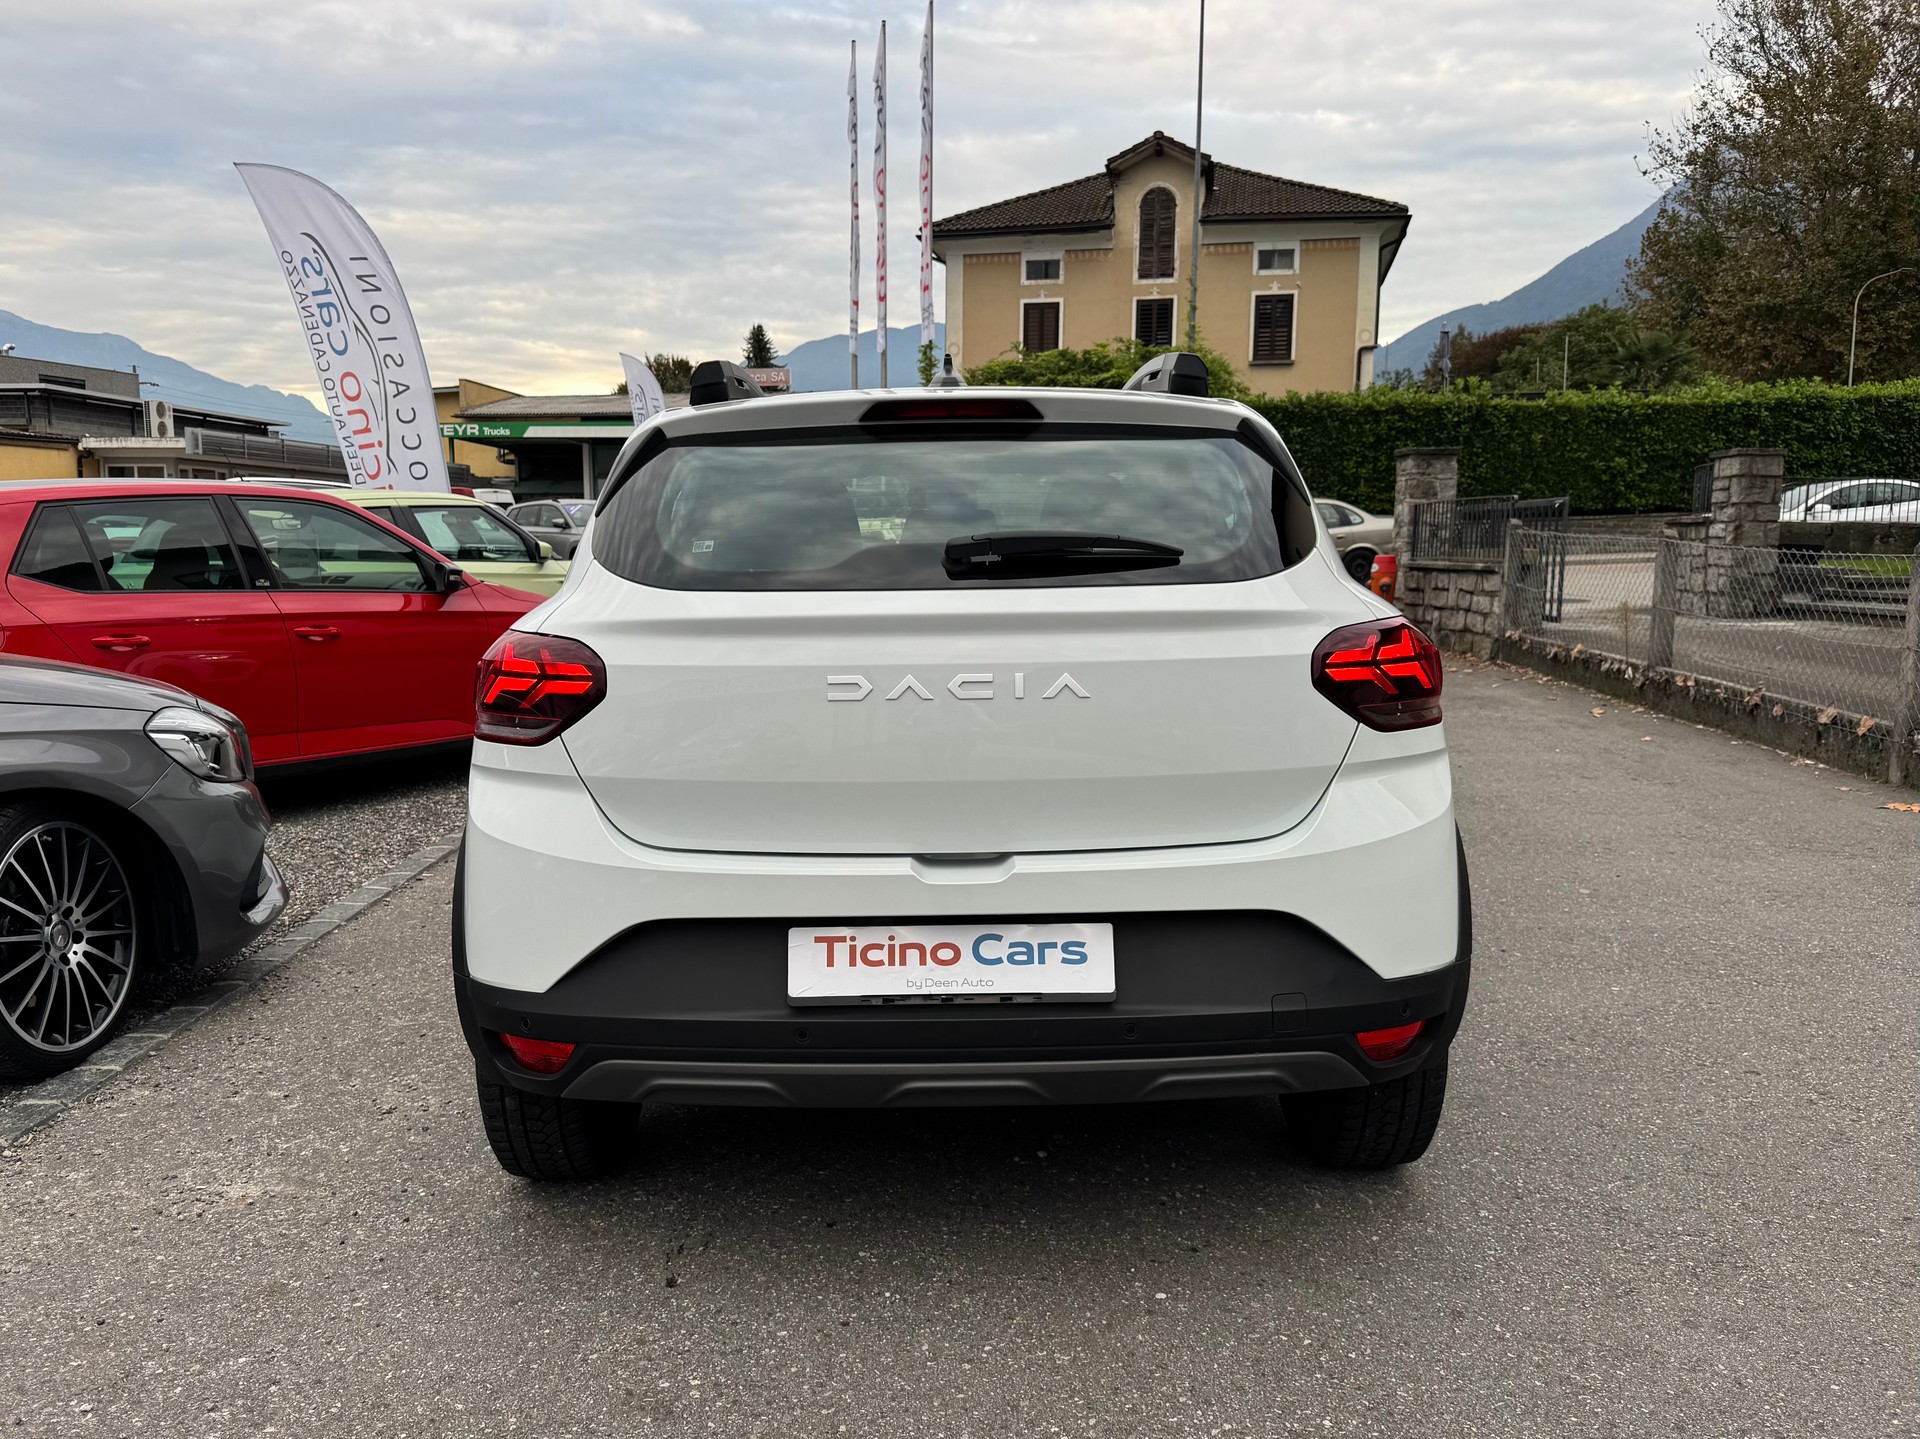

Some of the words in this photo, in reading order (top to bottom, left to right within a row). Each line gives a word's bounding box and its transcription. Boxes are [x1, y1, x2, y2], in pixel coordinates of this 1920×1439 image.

[770, 371, 785, 382] SA
[440, 423, 480, 436] EYR
[482, 426, 511, 436] Trucks
[827, 672, 1091, 702] DACIA
[813, 934, 962, 968] Ticino
[971, 932, 1089, 966] Cars
[906, 978, 923, 990] by
[924, 977, 959, 988] Deen
[960, 977, 994, 988] Auto
